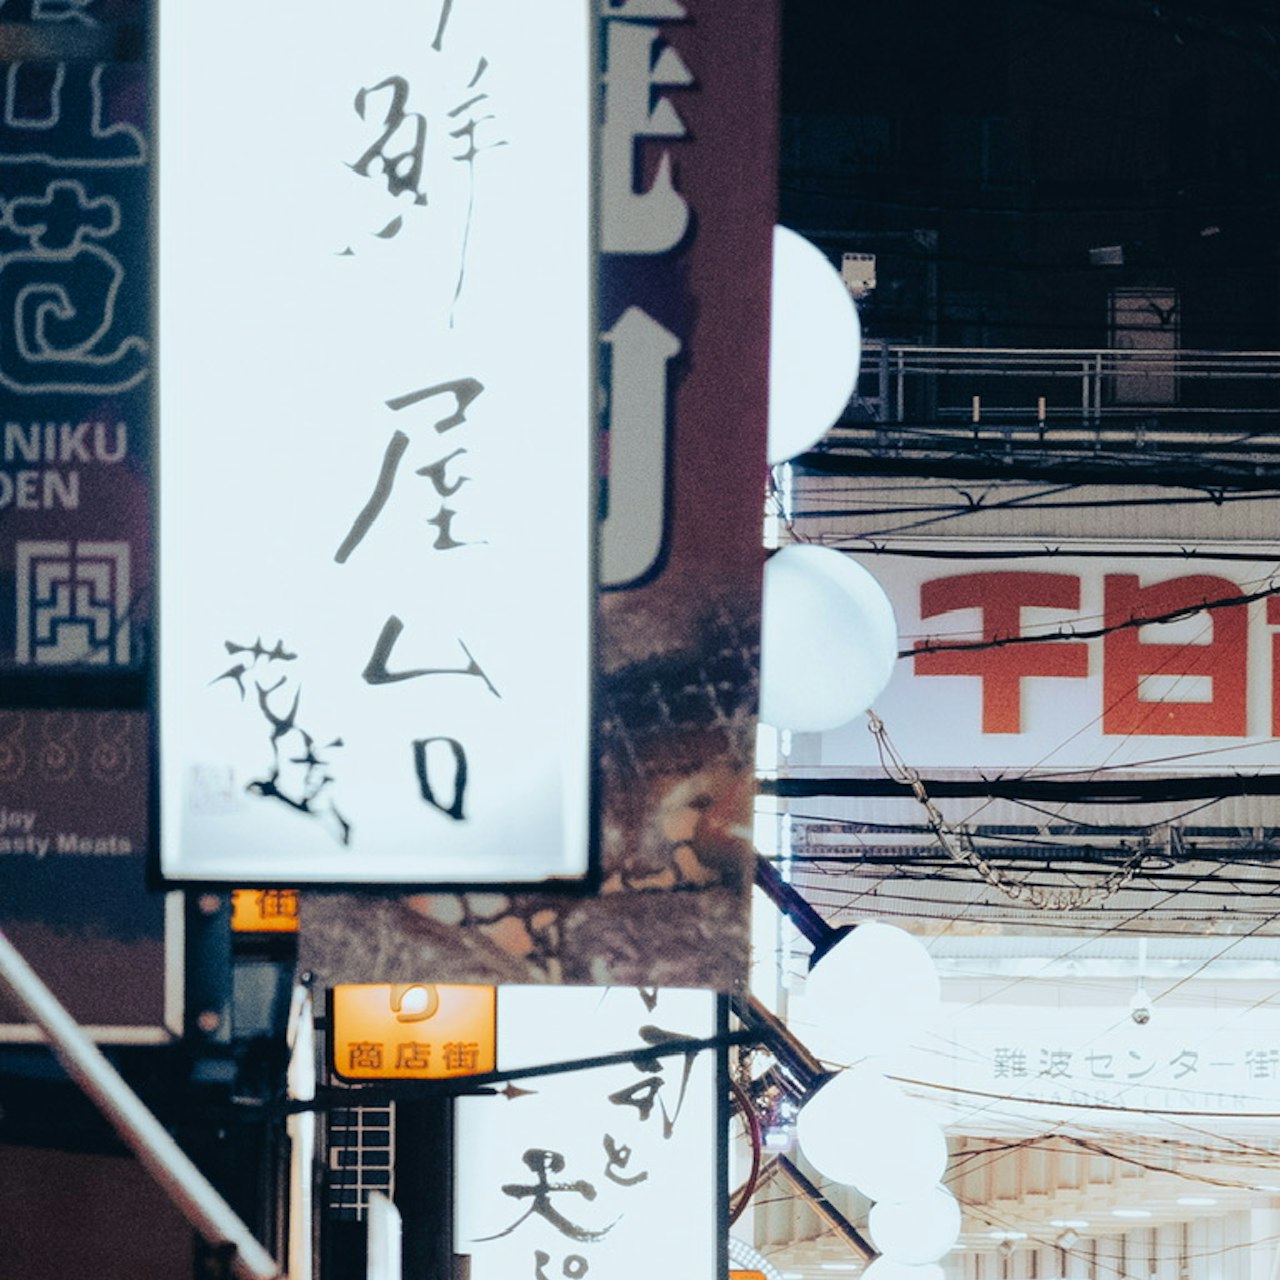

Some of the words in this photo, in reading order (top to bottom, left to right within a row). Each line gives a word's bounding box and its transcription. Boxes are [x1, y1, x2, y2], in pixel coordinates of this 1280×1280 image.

[347, 1041, 490, 1070] 商店街
[993, 1048, 1279, 1079] 難波センター街
[606, 986, 701, 1184] 司と
